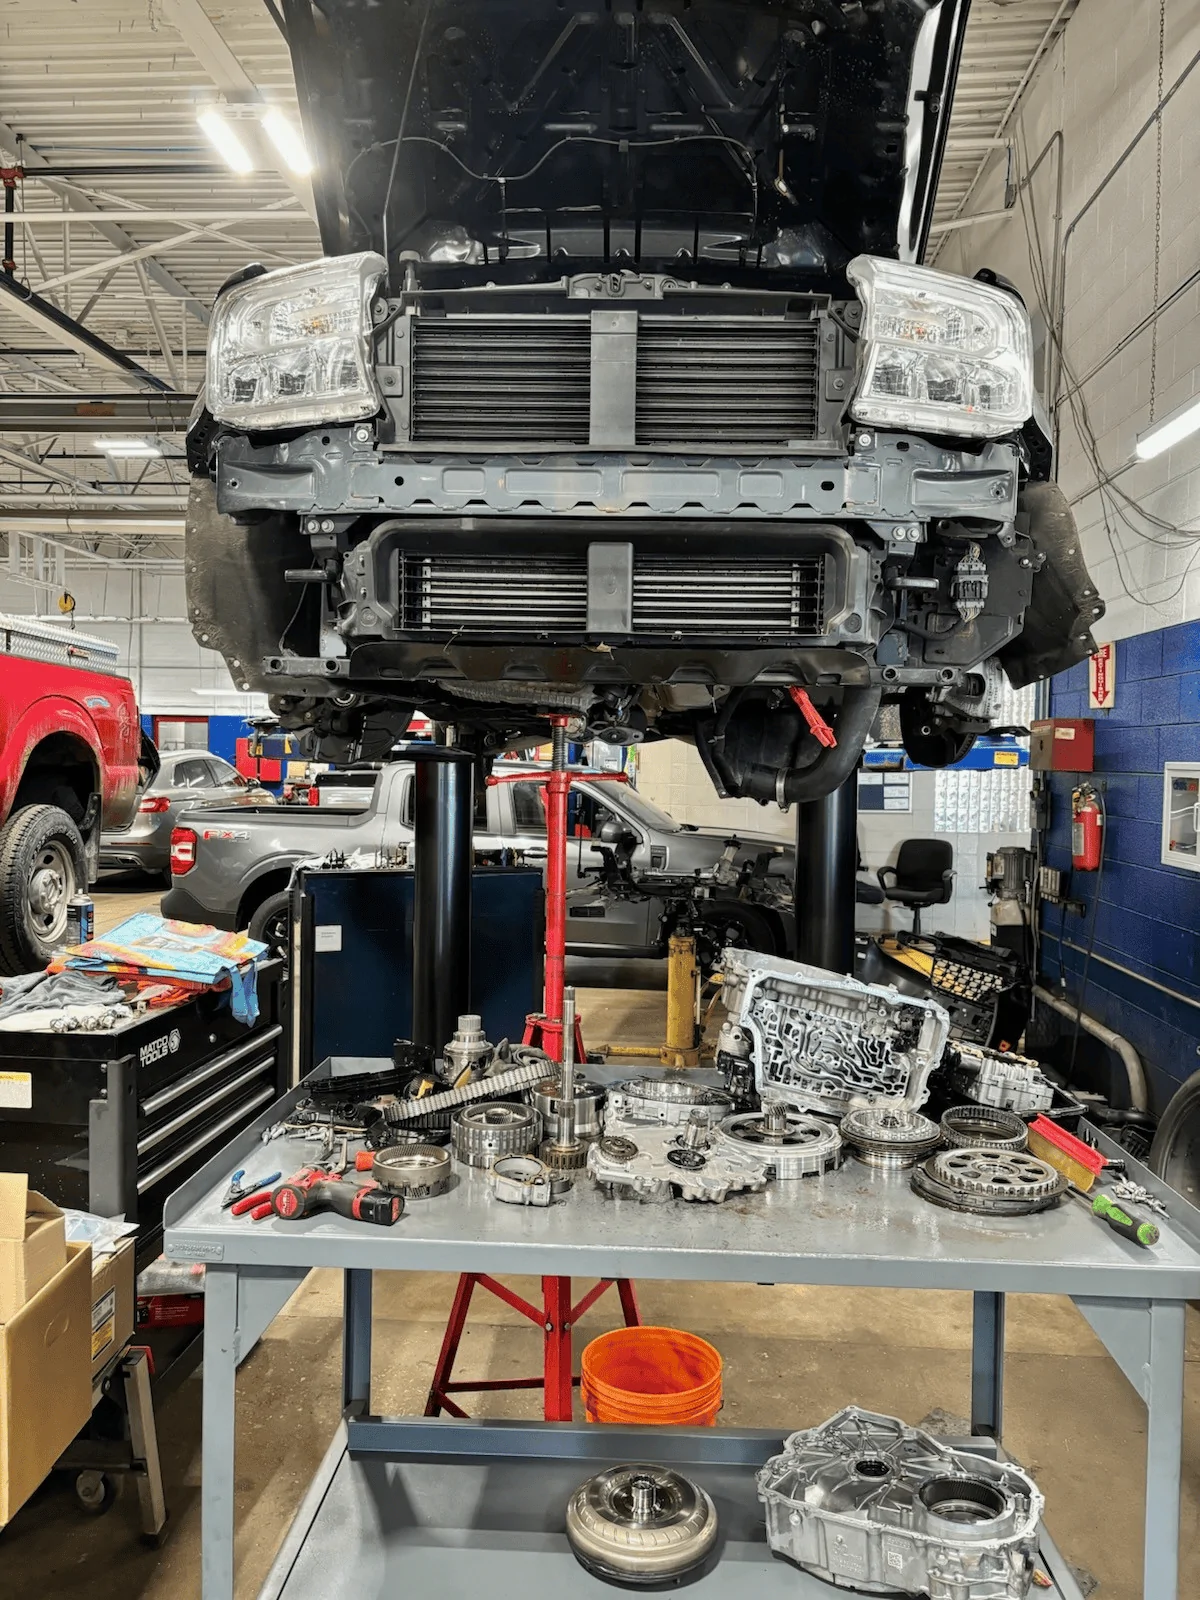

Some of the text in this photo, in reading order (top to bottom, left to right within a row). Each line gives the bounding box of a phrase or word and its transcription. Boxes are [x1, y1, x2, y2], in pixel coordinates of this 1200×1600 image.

[202, 829, 252, 841] FX4
[140, 1035, 169, 1058] MATCO
[140, 1047, 169, 1068] TOOLS
